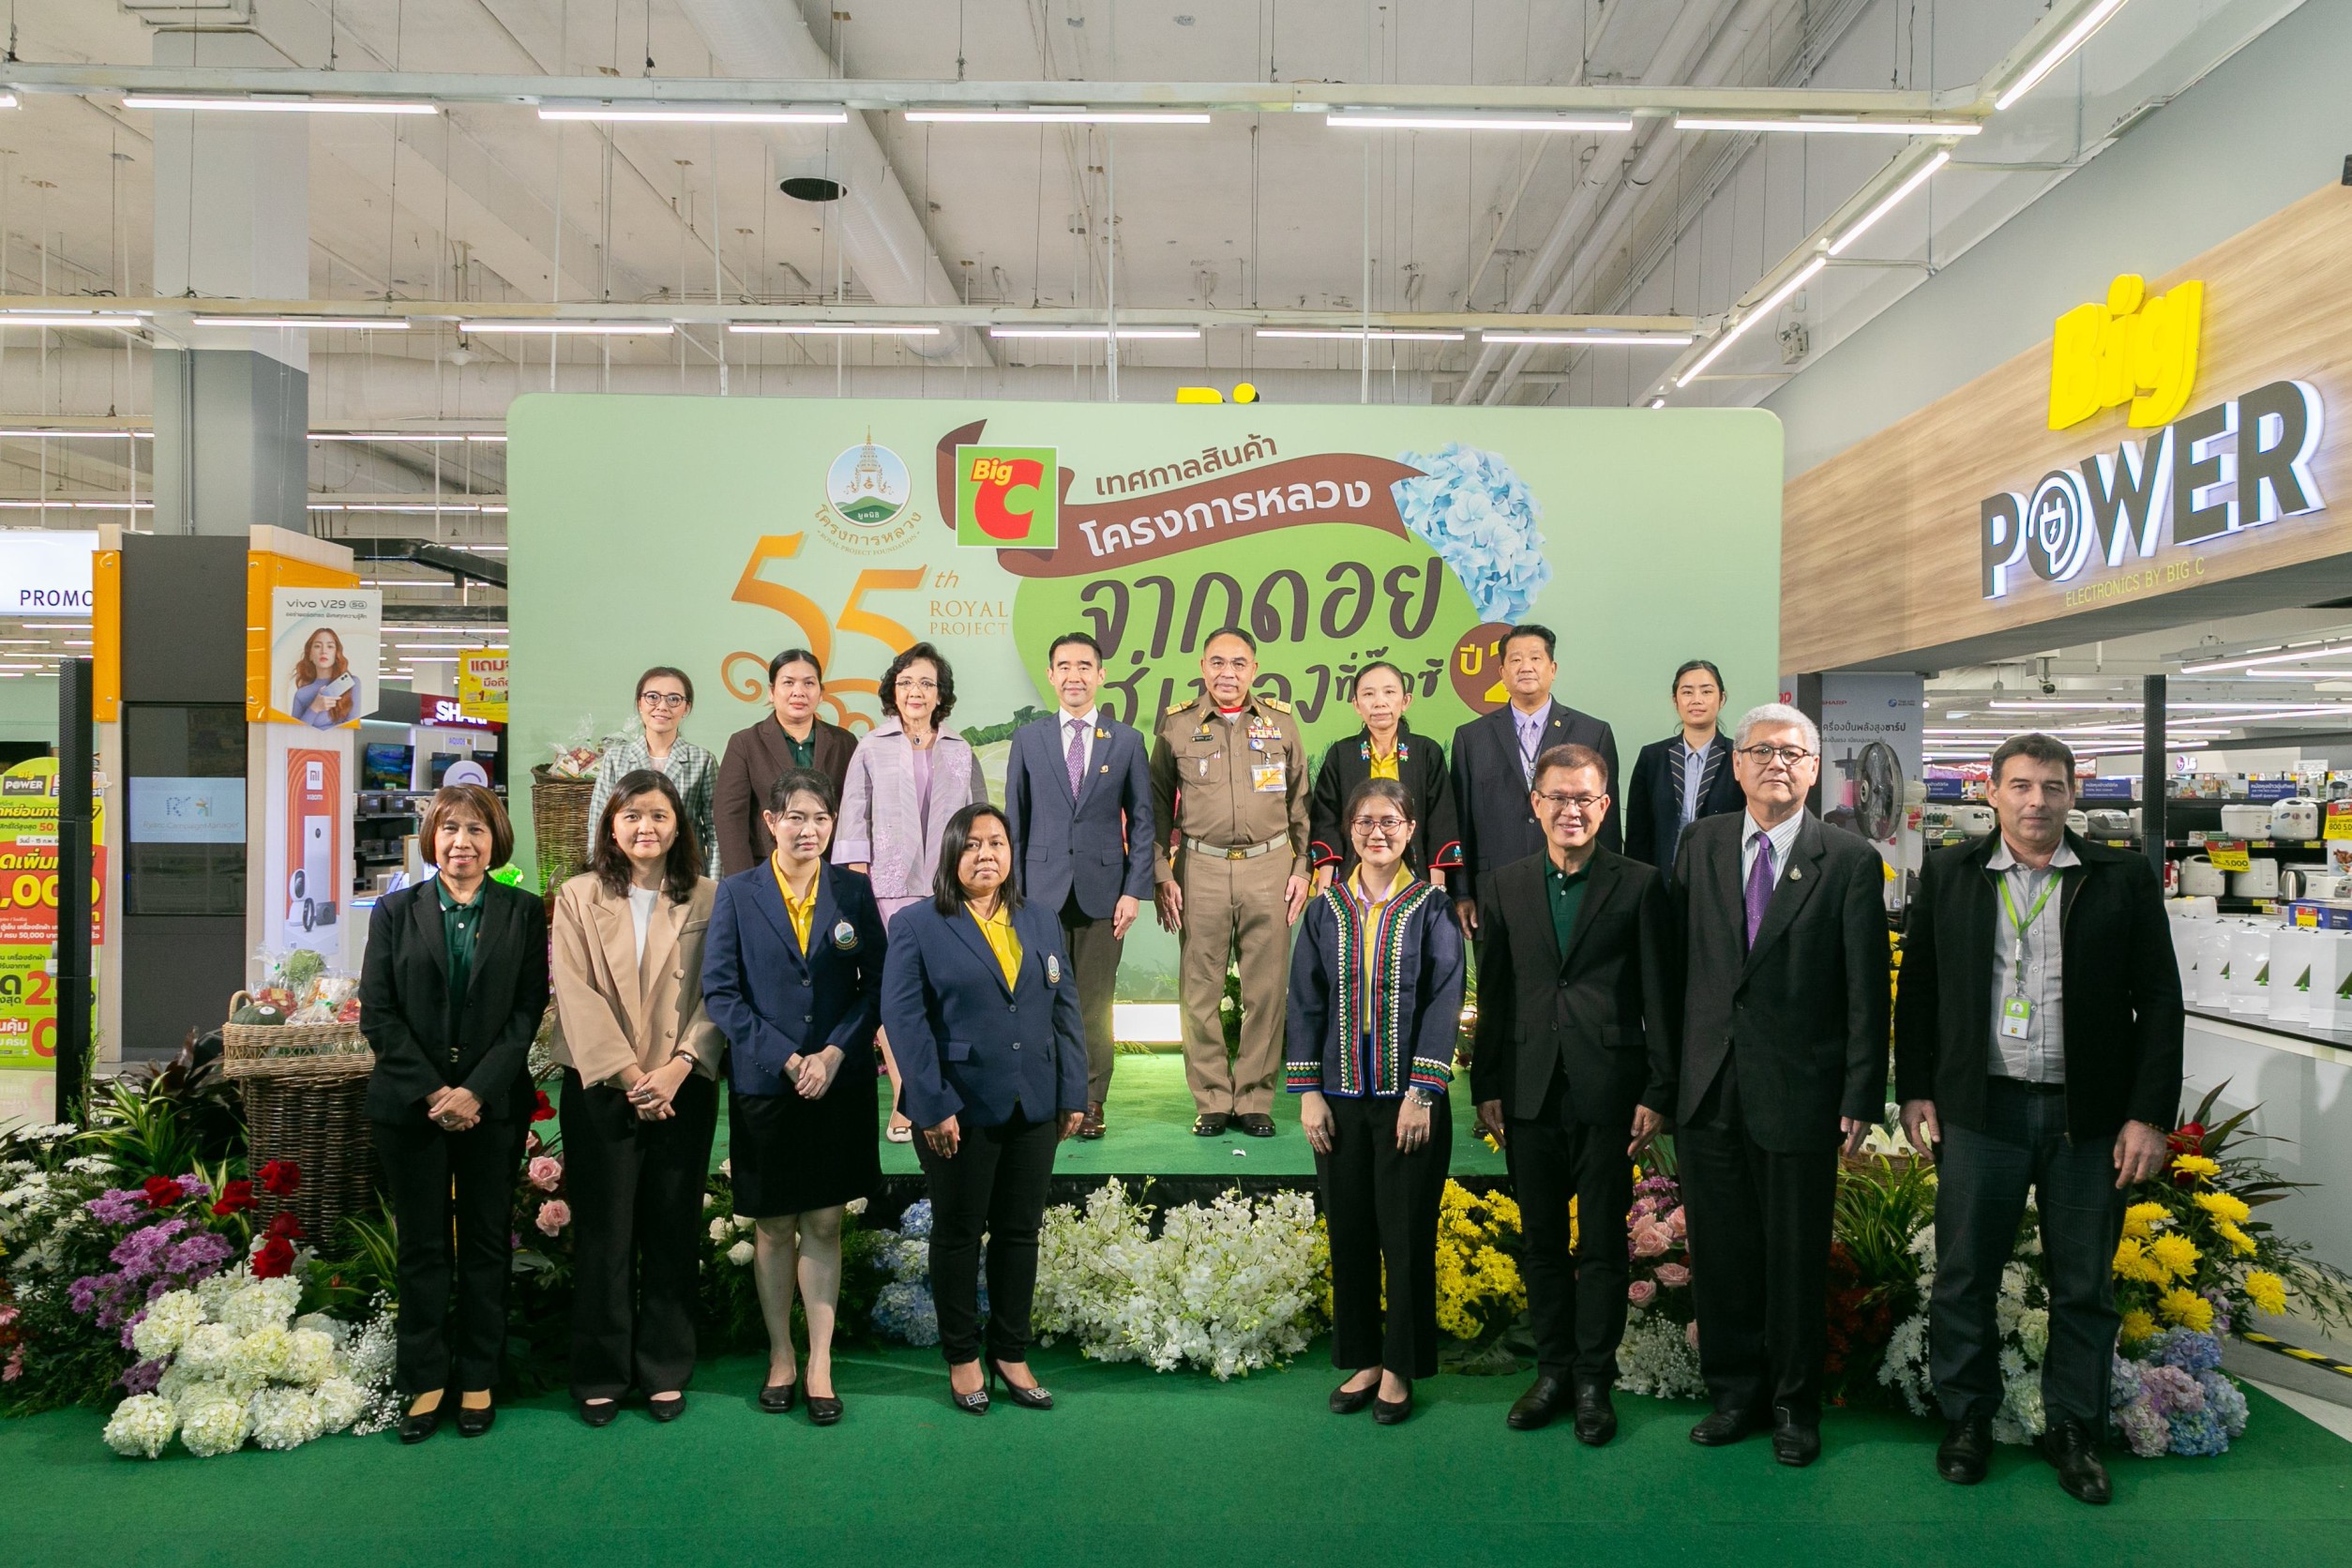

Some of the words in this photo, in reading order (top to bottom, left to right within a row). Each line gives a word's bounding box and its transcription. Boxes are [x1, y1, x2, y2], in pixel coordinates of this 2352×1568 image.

[2048, 274, 2205, 430] Big
[972, 458, 1014, 486] Big
[1095, 433, 1279, 496] เทศกาลสินค้า
[974, 459, 1045, 540] C
[1981, 380, 2327, 600] POWER
[814, 504, 923, 547] โครงการหลวง
[1078, 479, 1372, 558] โครงการหลวง
[840, 545, 872, 556] PROJECT
[872, 534, 918, 556] FOUNDATION
[2065, 573, 2140, 608] ELECTRONICS
[2145, 569, 2161, 588] BY
[2166, 561, 2190, 582] BIG
[2194, 556, 2206, 576] C
[286, 598, 317, 609] vivo
[320, 599, 346, 609] V29
[929, 600, 1009, 618] ROYAL
[1080, 556, 1444, 661] จากดอย
[929, 621, 1010, 638] PROJECT
[1459, 643, 1484, 676] ปี
[1822, 720, 1907, 734] ครื่องปั่นพลังสูงชาร์ป
[5, 780, 43, 790] POWER
